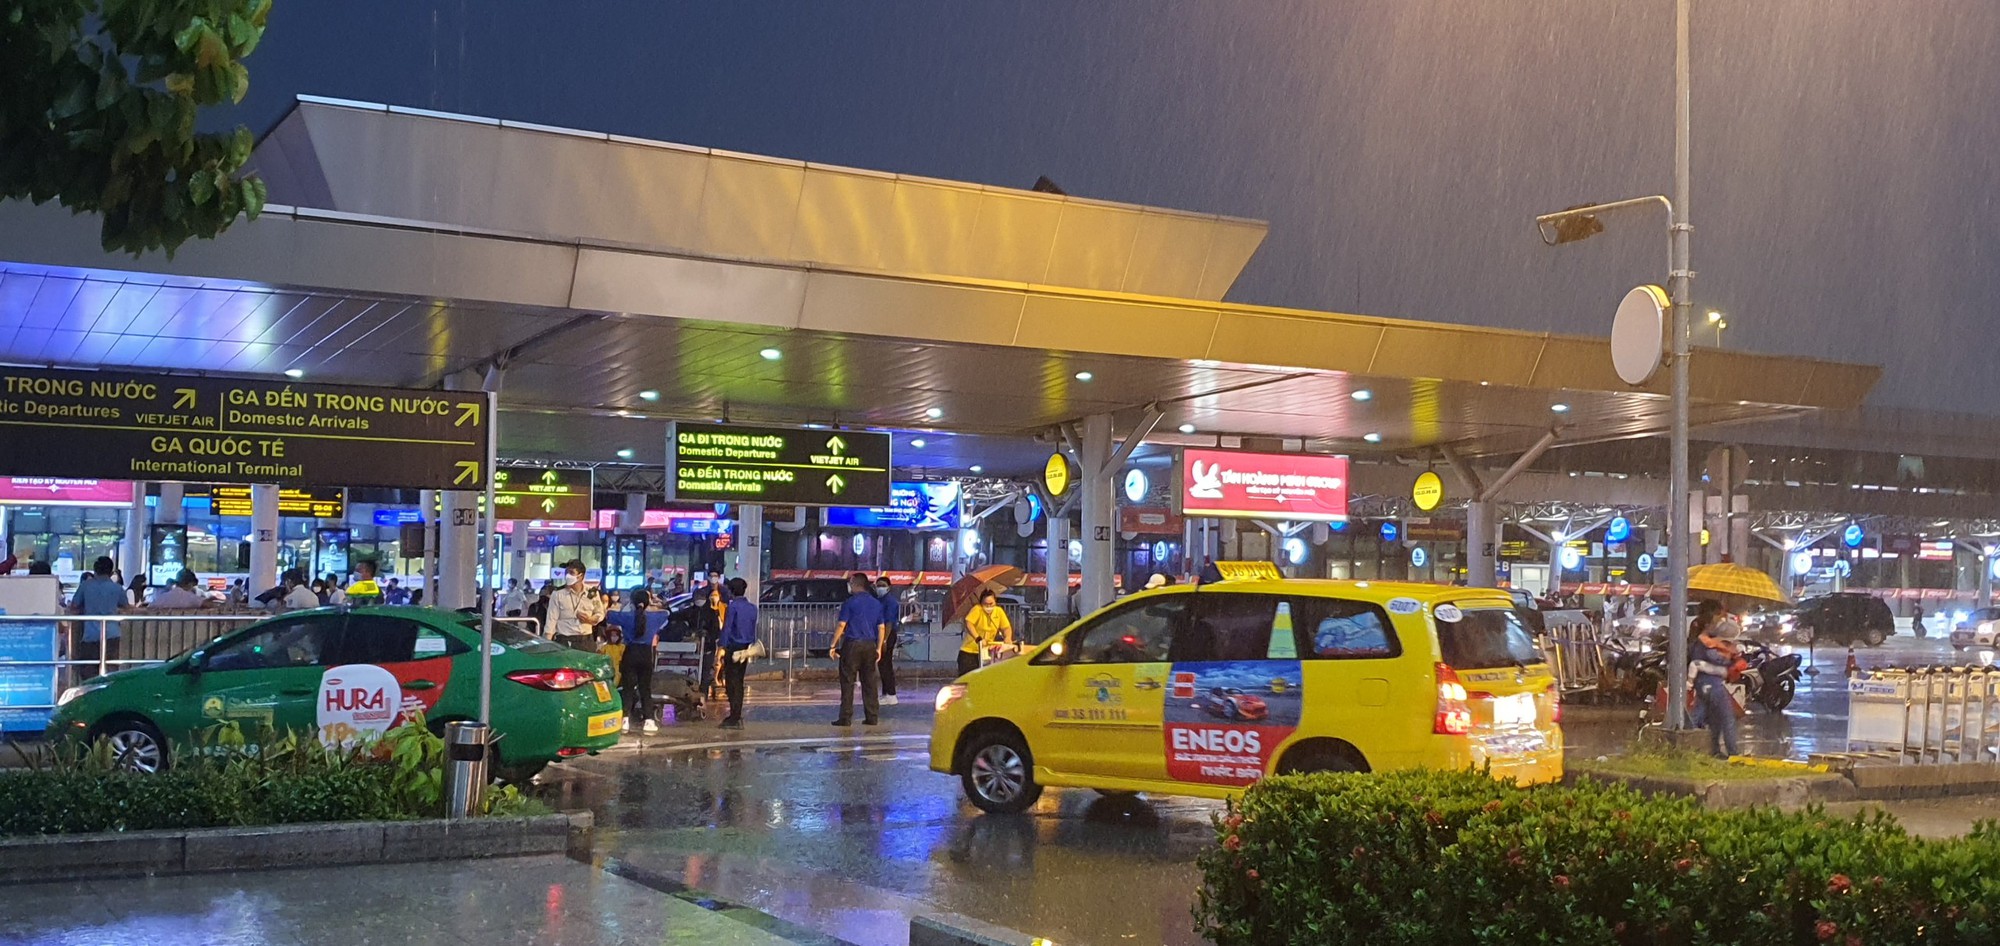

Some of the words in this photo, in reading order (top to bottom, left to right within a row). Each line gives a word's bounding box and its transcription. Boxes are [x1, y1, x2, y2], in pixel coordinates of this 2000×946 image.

[4, 376, 84, 397] TRONG
[90, 379, 157, 400] NƯỚC
[229, 388, 259, 406] GA
[264, 384, 307, 408] ĐẾN
[313, 393, 385, 413] TRONG
[390, 396, 450, 416] NƯỚC
[24, 401, 120, 418] Departures
[135, 413, 189, 426] VIETJET
[191, 415, 214, 427] AIR
[229, 410, 305, 427] Domestic
[308, 414, 369, 430] Arrivals
[151, 436, 184, 453] GA
[188, 436, 252, 457] QUỐC
[258, 438, 285, 458] TẾ
[678, 433, 696, 444] GA
[697, 434, 710, 445] ĐI
[711, 434, 750, 447] TRONG
[751, 435, 783, 448] NƯỚC
[679, 446, 723, 456] Domestic
[725, 448, 776, 459] Departures
[810, 455, 844, 465] VIETJET
[845, 457, 860, 466] AIR
[130, 457, 231, 475] International
[236, 461, 303, 477] Terminal
[678, 468, 696, 478] GA
[697, 465, 721, 479] ĐẾN
[723, 469, 761, 480] TRONG
[762, 469, 794, 482] NƯỚC
[678, 480, 723, 490] Domestic
[724, 481, 762, 492] Arrivals
[325, 687, 384, 712] HURA
[1171, 728, 1261, 754] ENEOS
